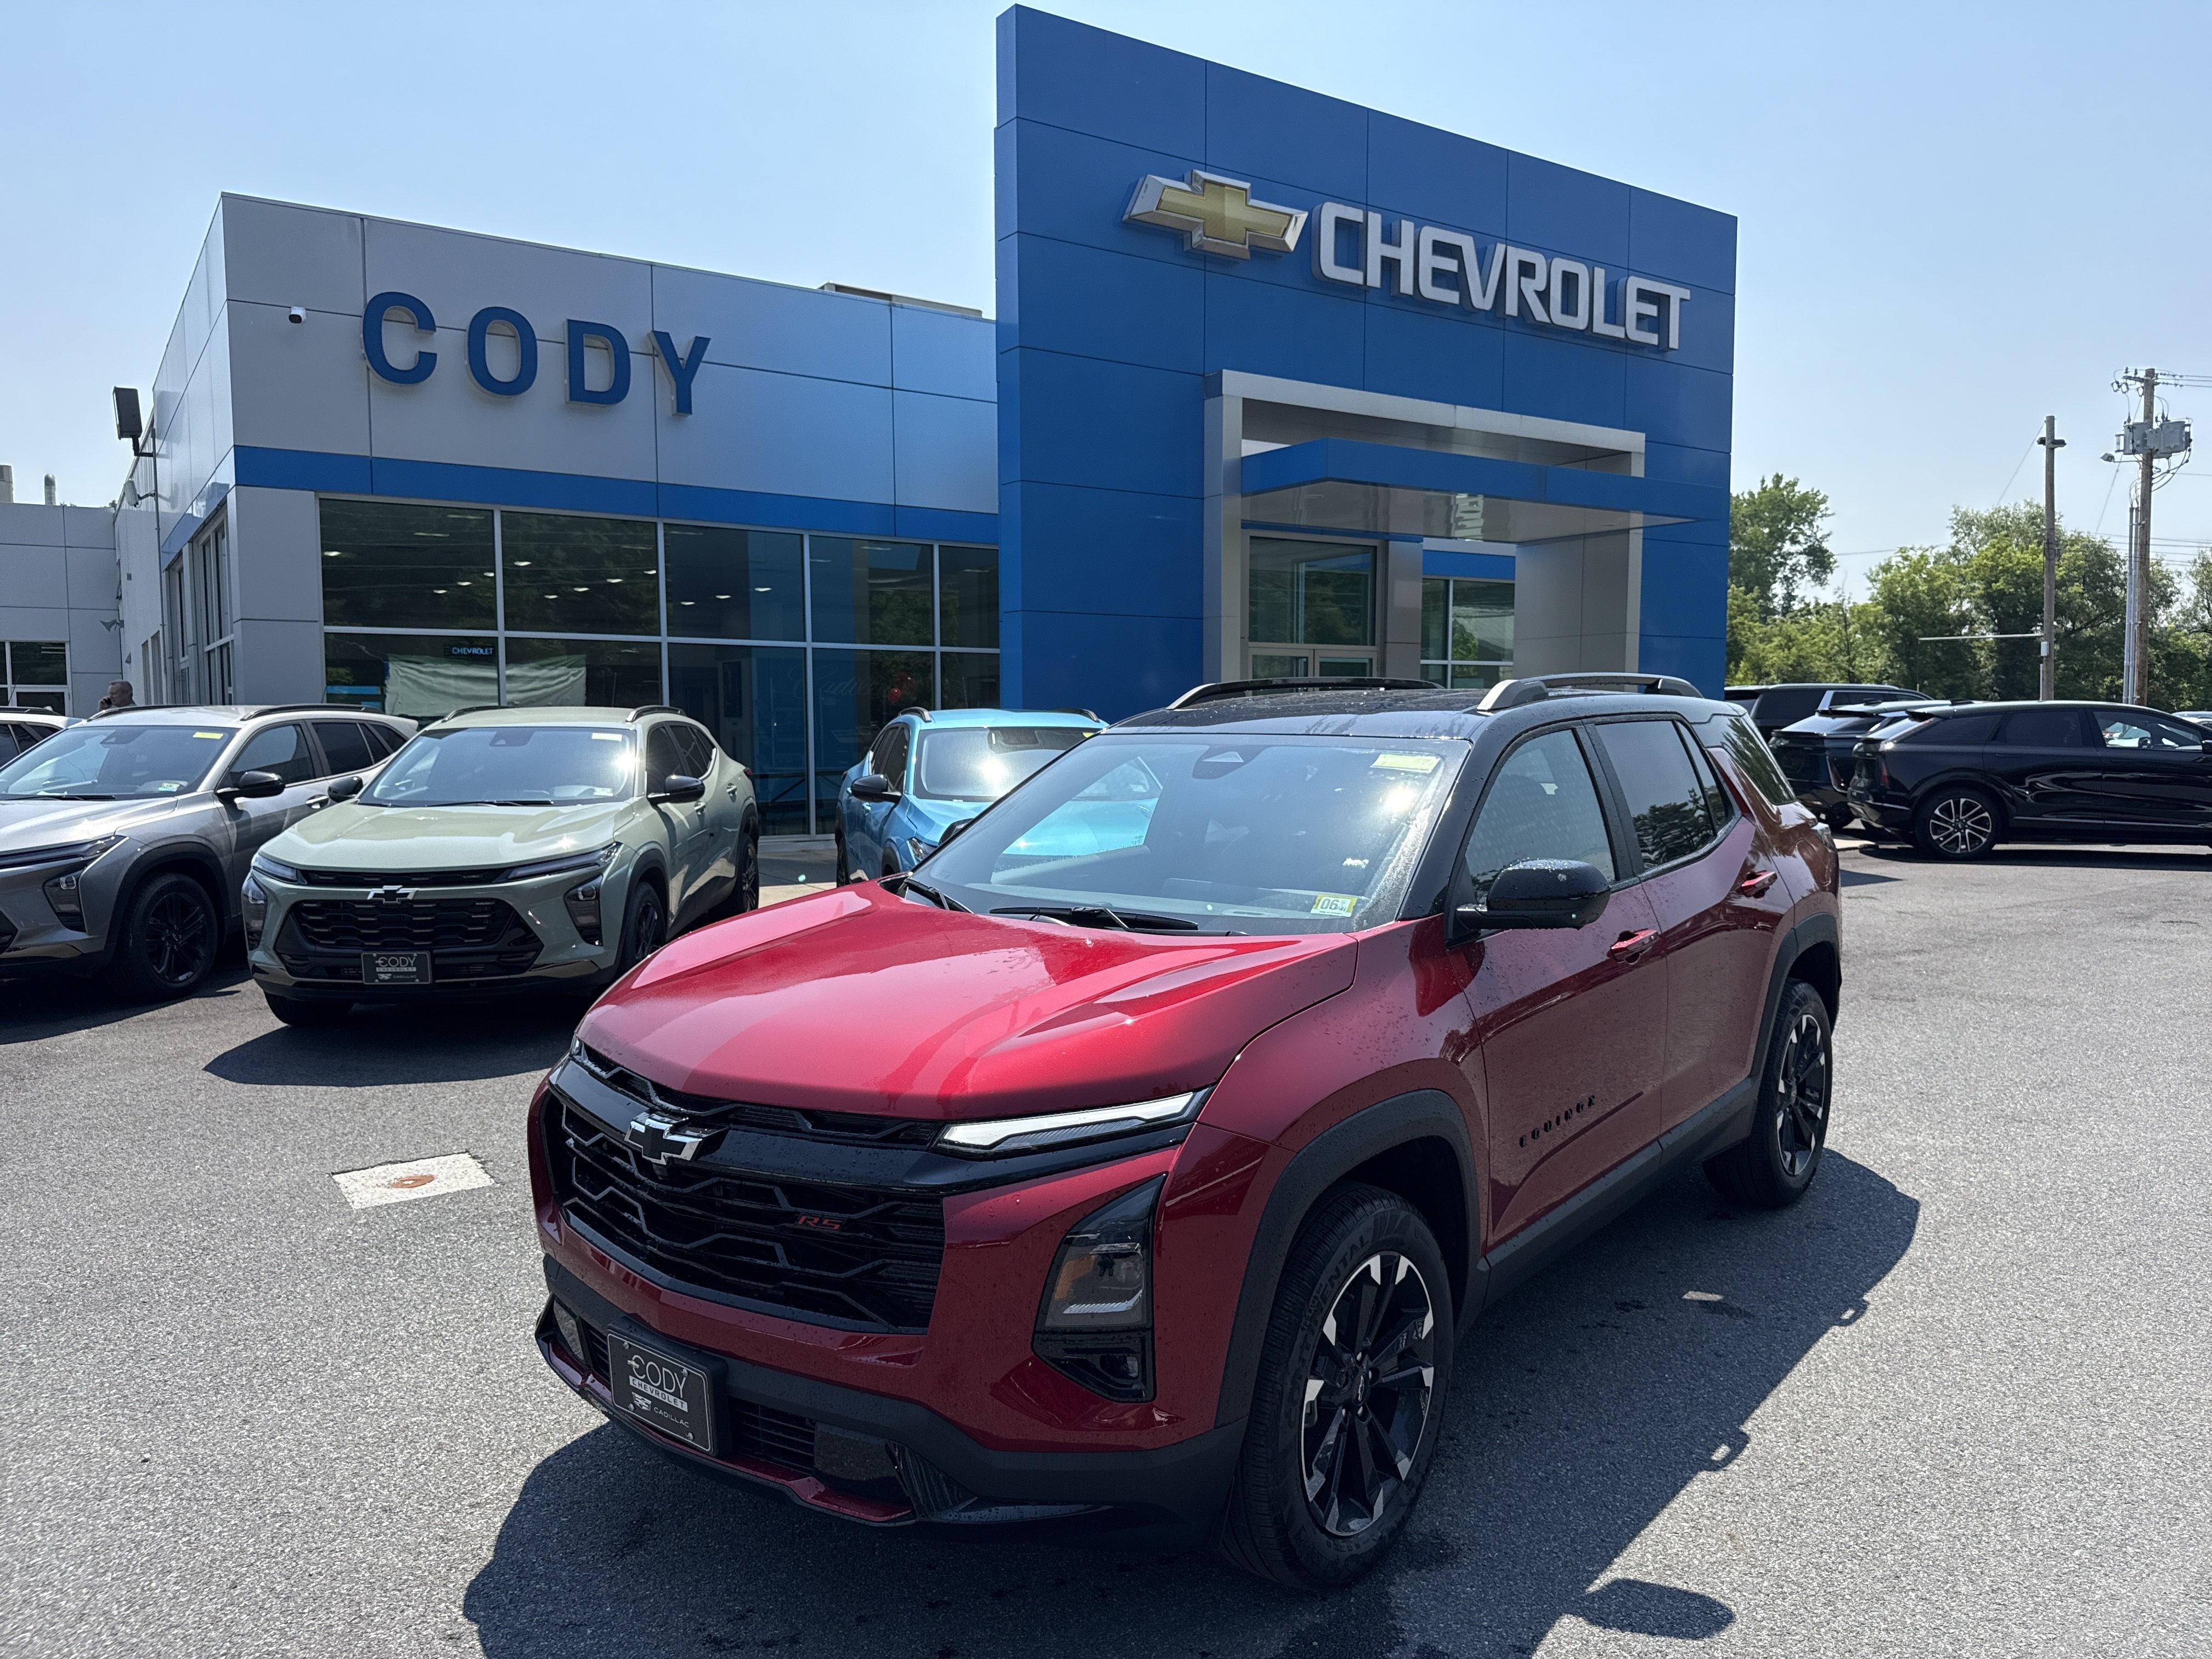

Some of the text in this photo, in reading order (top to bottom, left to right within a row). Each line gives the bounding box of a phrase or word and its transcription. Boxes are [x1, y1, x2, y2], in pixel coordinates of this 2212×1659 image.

[1316, 201, 1690, 350] CHEVROLET
[362, 291, 711, 416] CODY
[378, 956, 416, 967] CODY
[1519, 1095, 1595, 1148] EQUINOX
[798, 1215, 843, 1229] RS
[631, 1355, 686, 1398] CODY
[632, 1379, 685, 1409] CHEVROLET
[653, 1407, 690, 1427] CADILLAC
